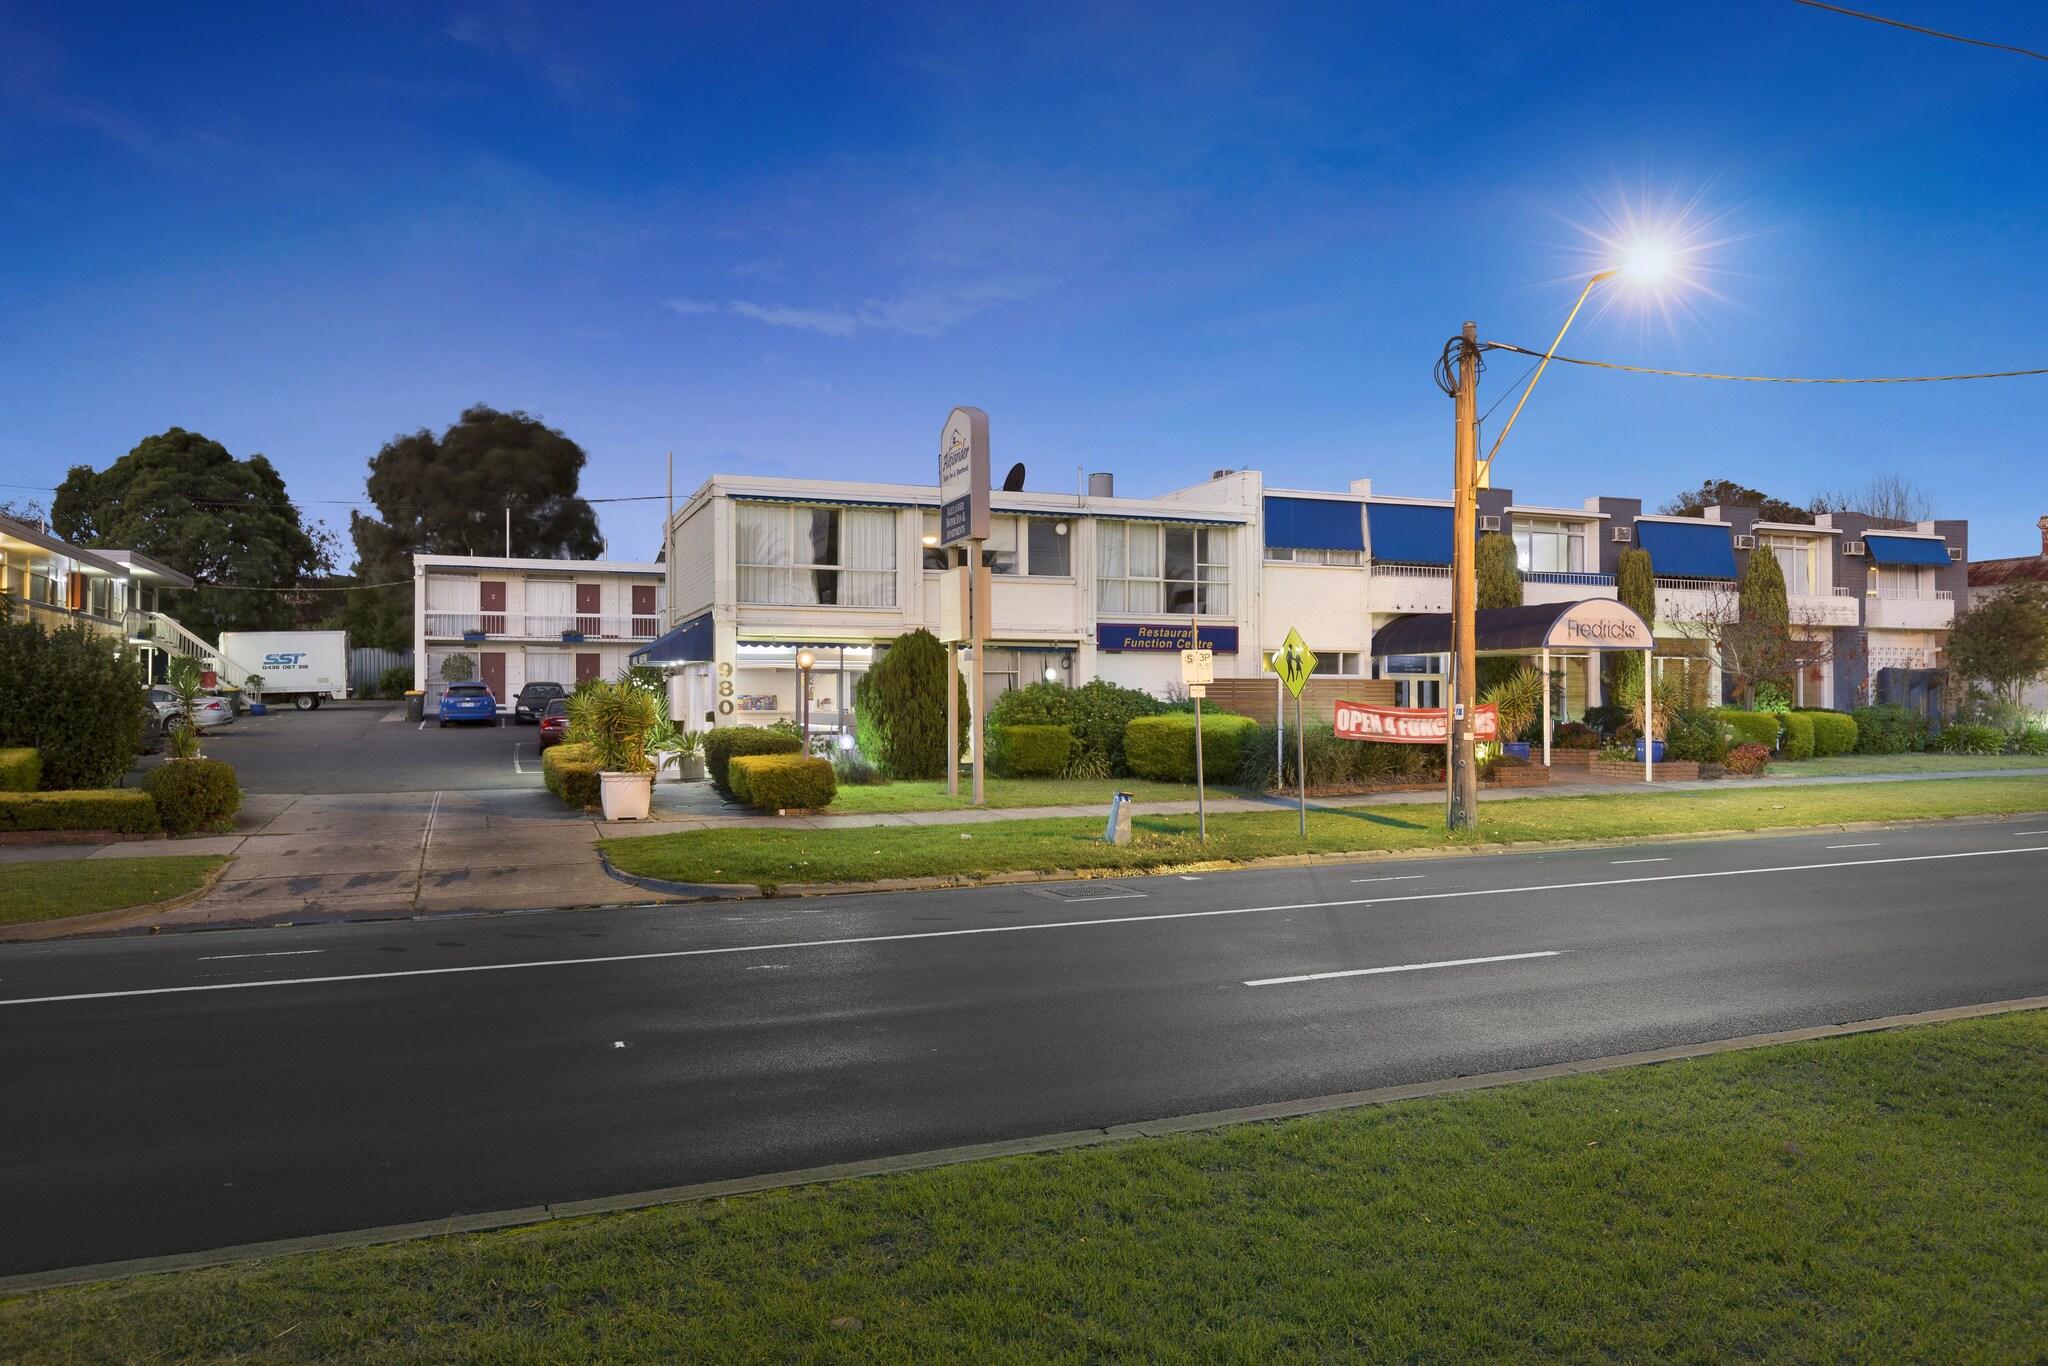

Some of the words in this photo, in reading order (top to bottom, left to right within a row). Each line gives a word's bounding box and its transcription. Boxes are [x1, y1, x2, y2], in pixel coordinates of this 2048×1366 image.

[1138, 627, 1199, 639] Restauran
[1567, 619, 1636, 639] Fredricks
[1124, 638, 1172, 649] Function
[264, 653, 306, 664] SST
[1199, 653, 1210, 662] 3P
[1337, 708, 1383, 734] OPEN
[1384, 716, 1398, 736] 4
